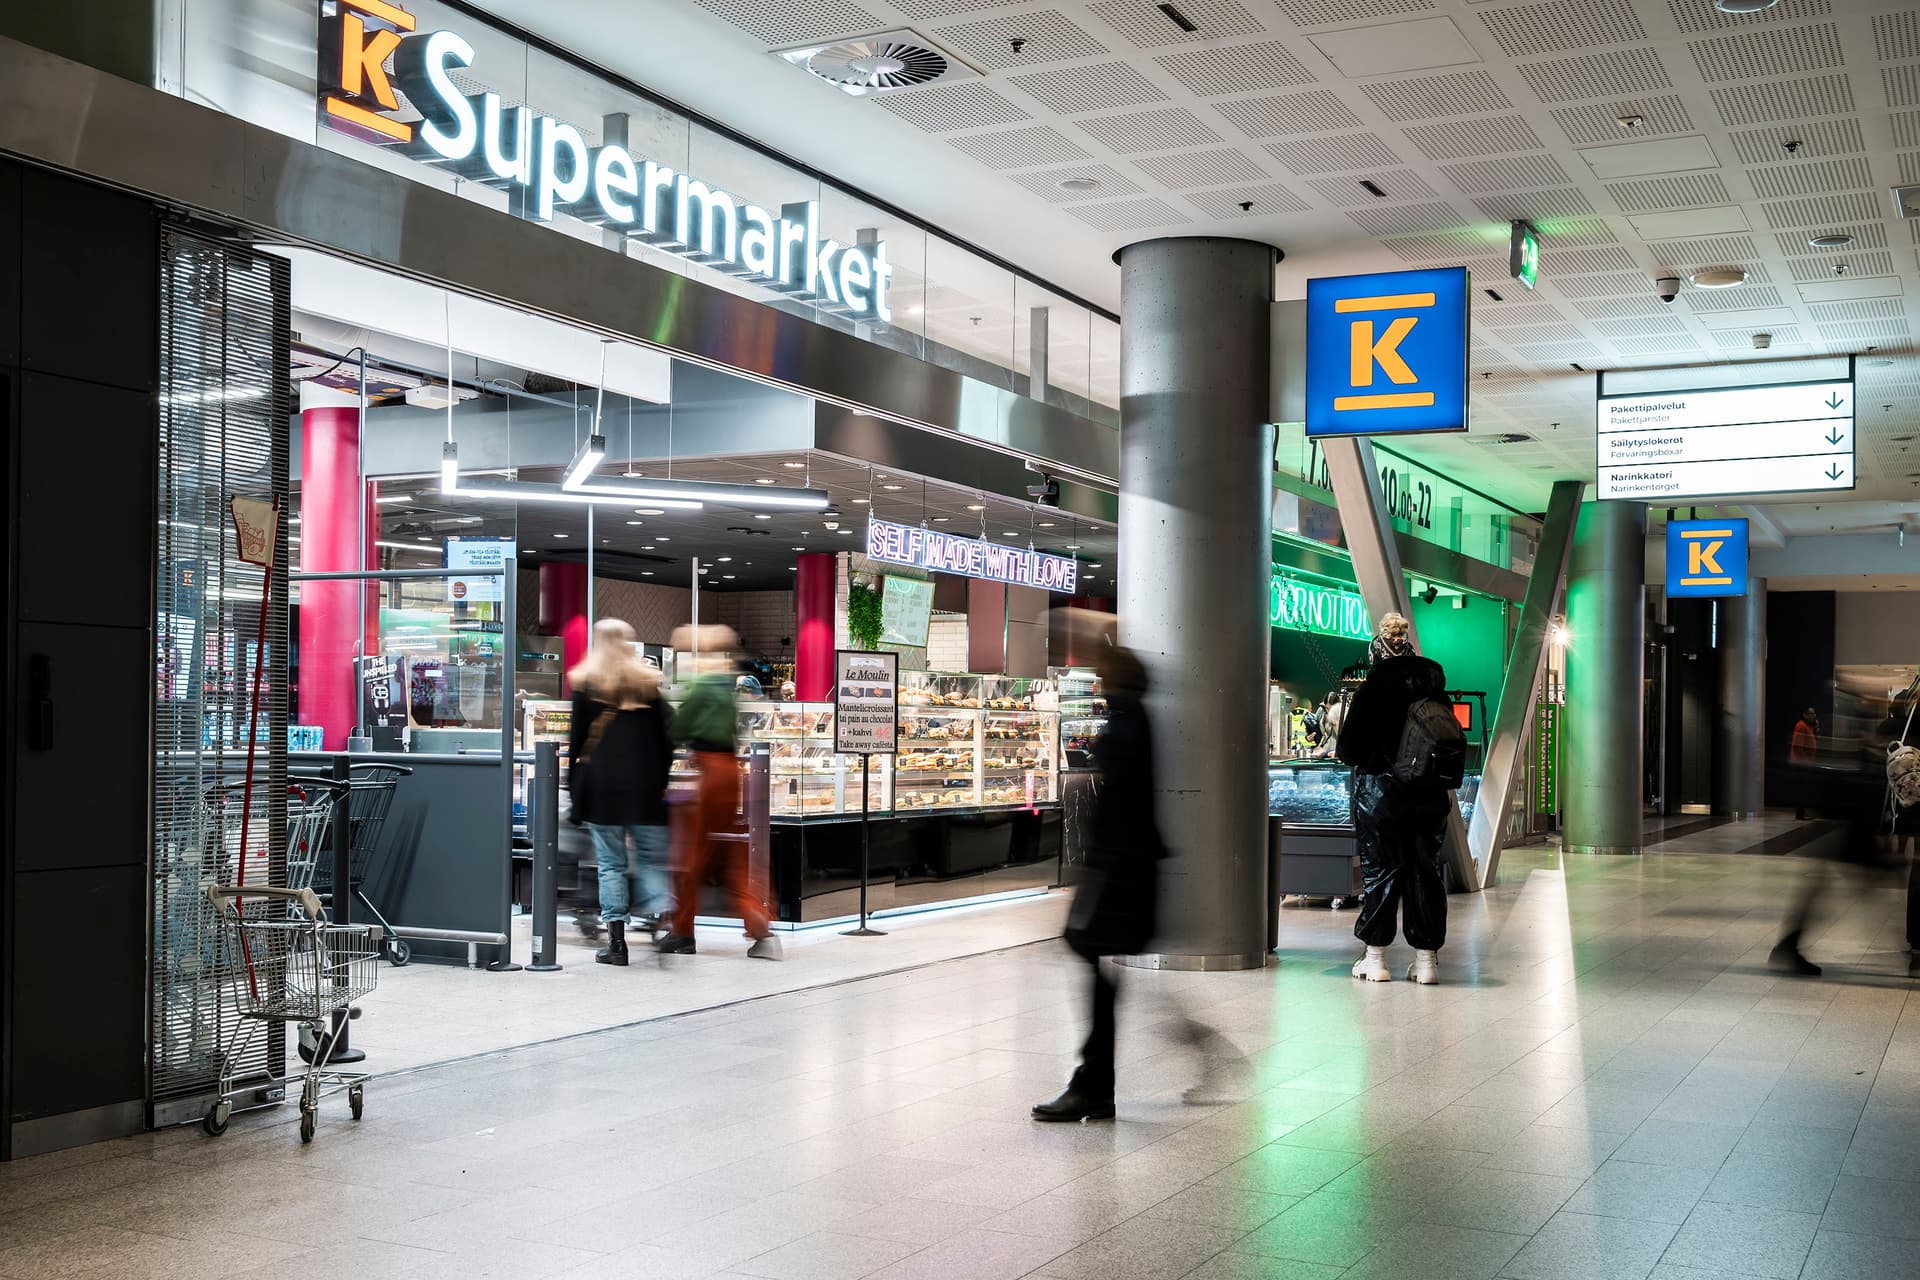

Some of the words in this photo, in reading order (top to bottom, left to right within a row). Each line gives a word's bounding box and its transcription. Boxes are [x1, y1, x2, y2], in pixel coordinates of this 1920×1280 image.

[342, 12, 402, 111] K
[420, 30, 893, 322] Supermarket
[1350, 317, 1419, 387] K
[1611, 402, 1686, 413] Pakettipalvelut
[1611, 471, 1673, 481] Narinkkatori
[1611, 483, 1680, 492] Narinkentorget
[1382, 466, 1431, 529] 10.00-22
[871, 523, 921, 562] SELF
[926, 534, 981, 575] MADE
[986, 545, 1029, 582] WITH
[1034, 555, 1076, 591] LOVE
[1688, 540, 1725, 576] K
[846, 669, 856, 680] Le
[858, 670, 889, 680] Moulin
